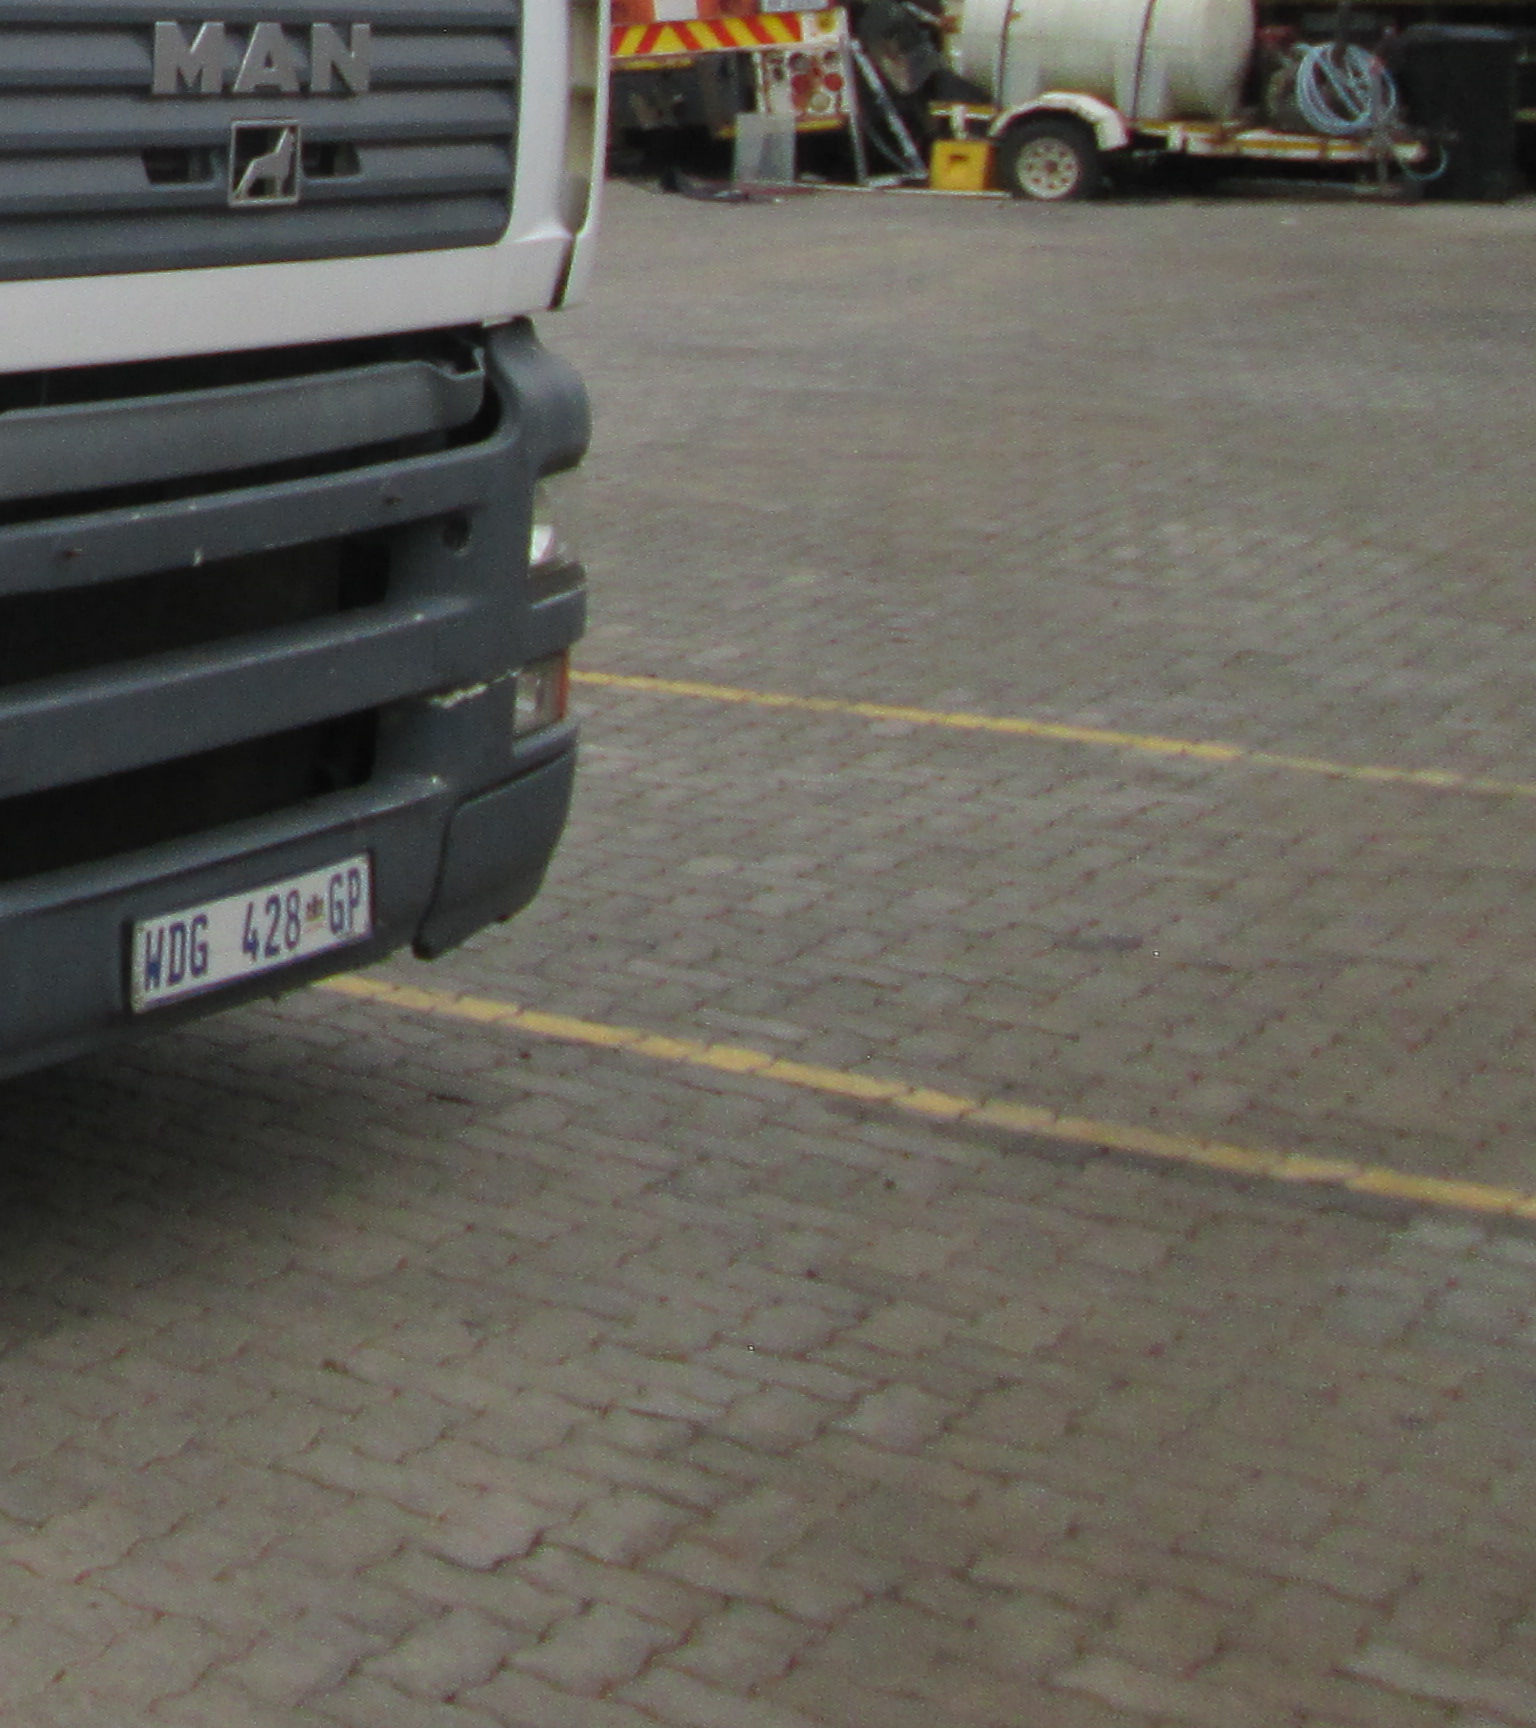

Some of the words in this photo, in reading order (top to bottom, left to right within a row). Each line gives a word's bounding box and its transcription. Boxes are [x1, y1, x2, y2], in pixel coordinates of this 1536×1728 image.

[152, 20, 371, 94] MAN
[144, 913, 209, 993] WDG
[242, 889, 301, 964] 428
[329, 867, 362, 935] GP
